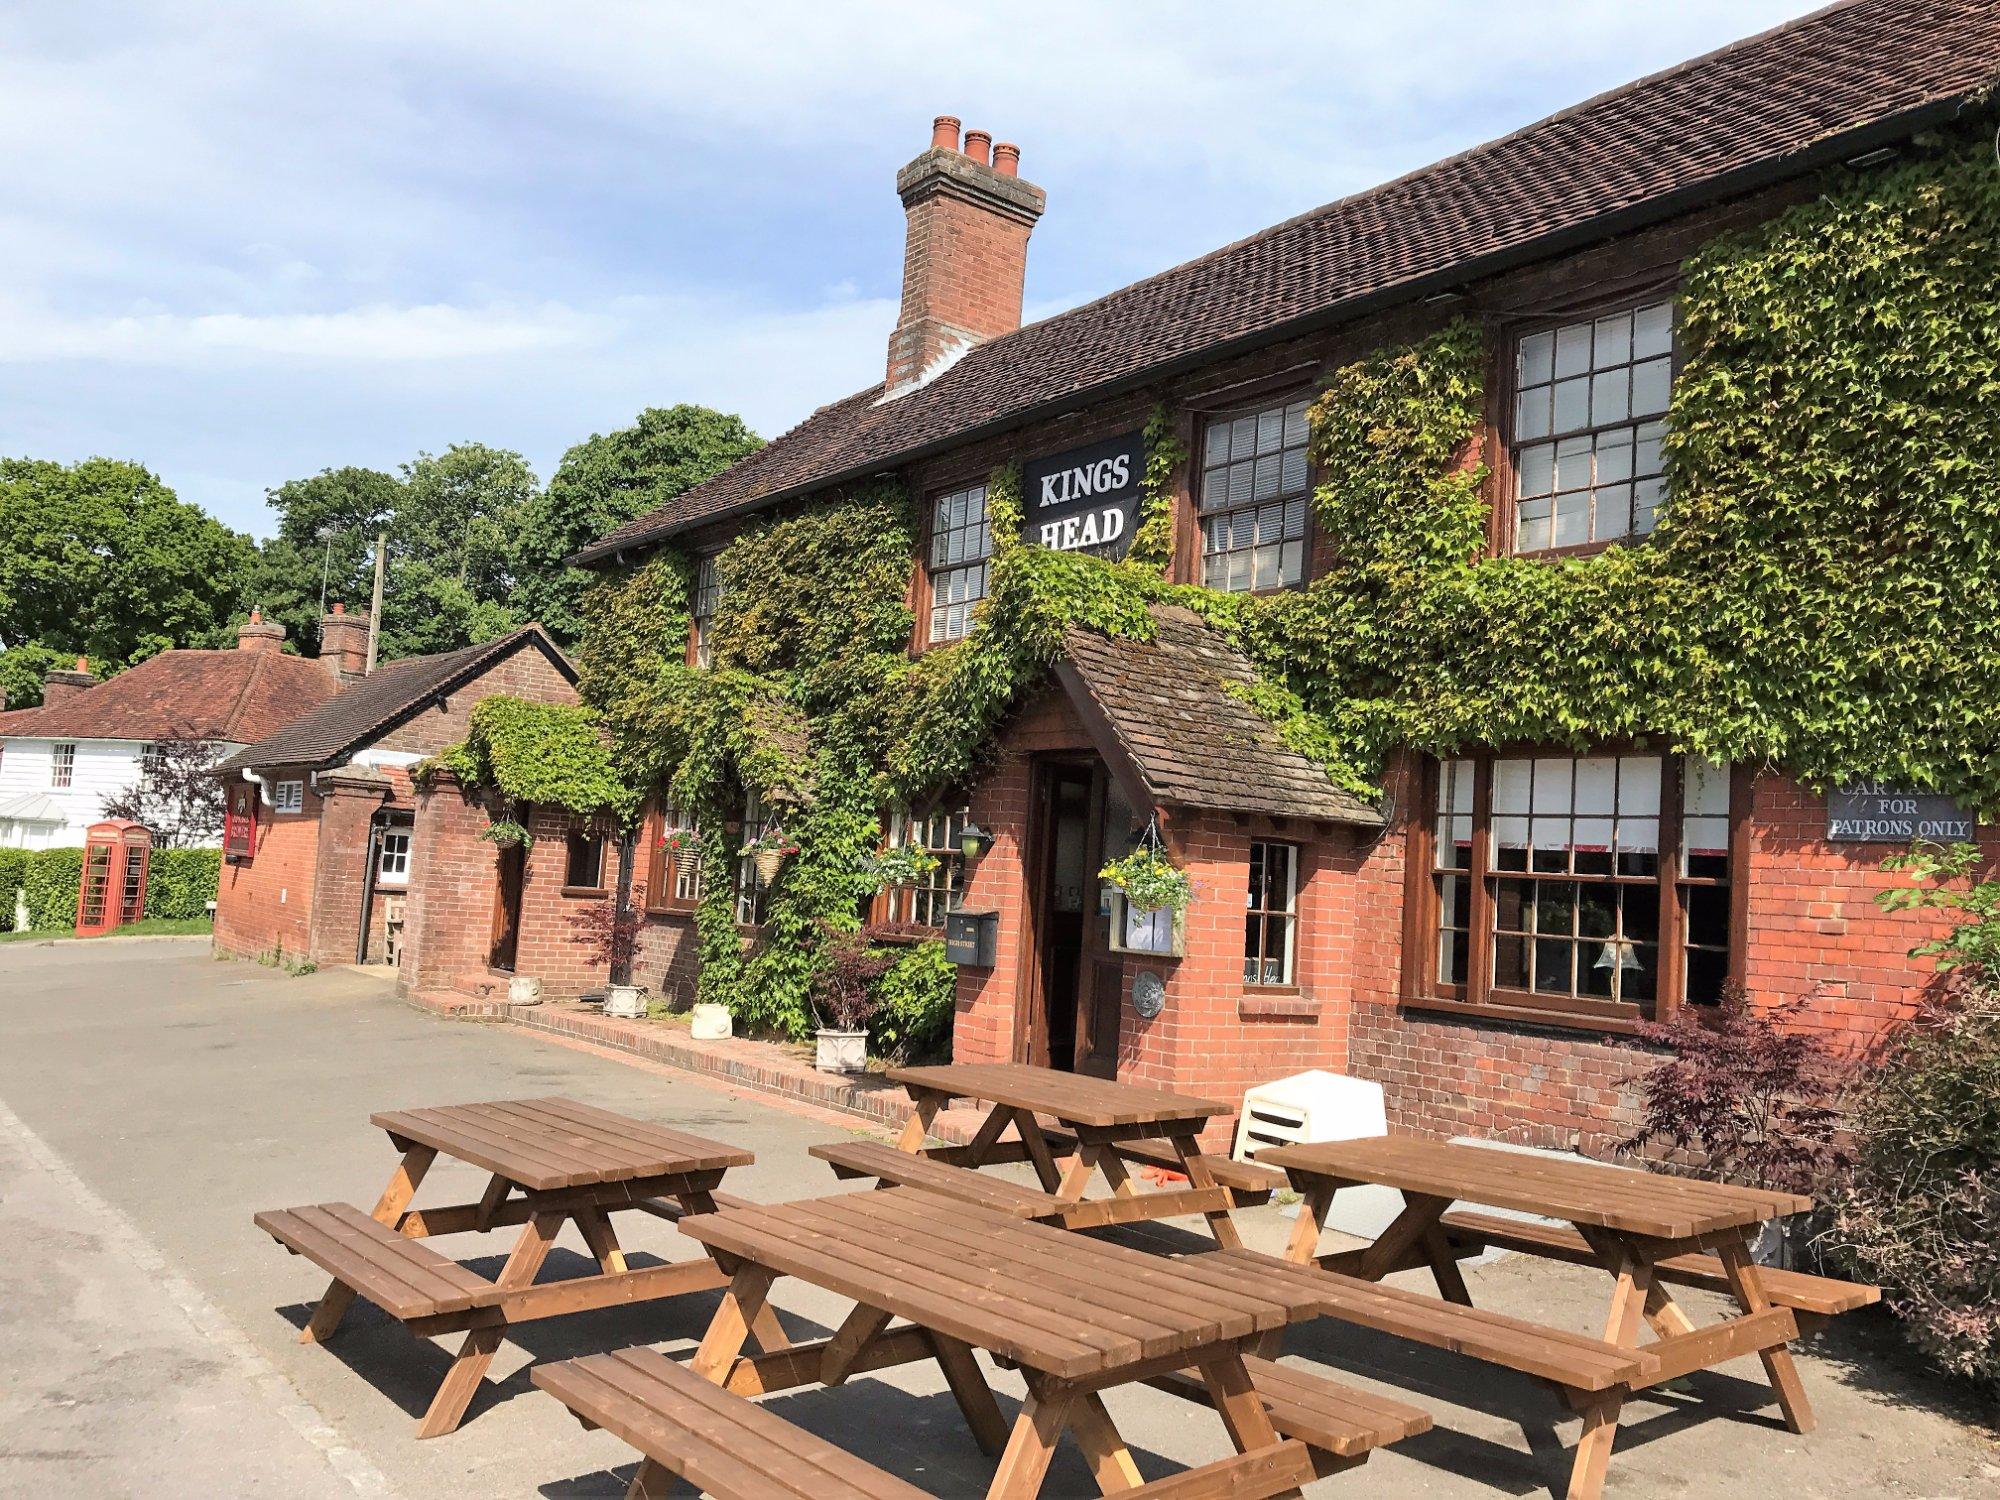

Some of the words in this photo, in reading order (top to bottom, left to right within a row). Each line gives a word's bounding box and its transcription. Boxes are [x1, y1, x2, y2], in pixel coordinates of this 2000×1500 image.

[1039, 454, 1130, 508] KINGS
[1040, 508, 1124, 551] HEAD
[1878, 799, 1918, 815] FOR
[1831, 819, 1913, 836] PATRONS
[1918, 821, 1969, 837] ONLY
